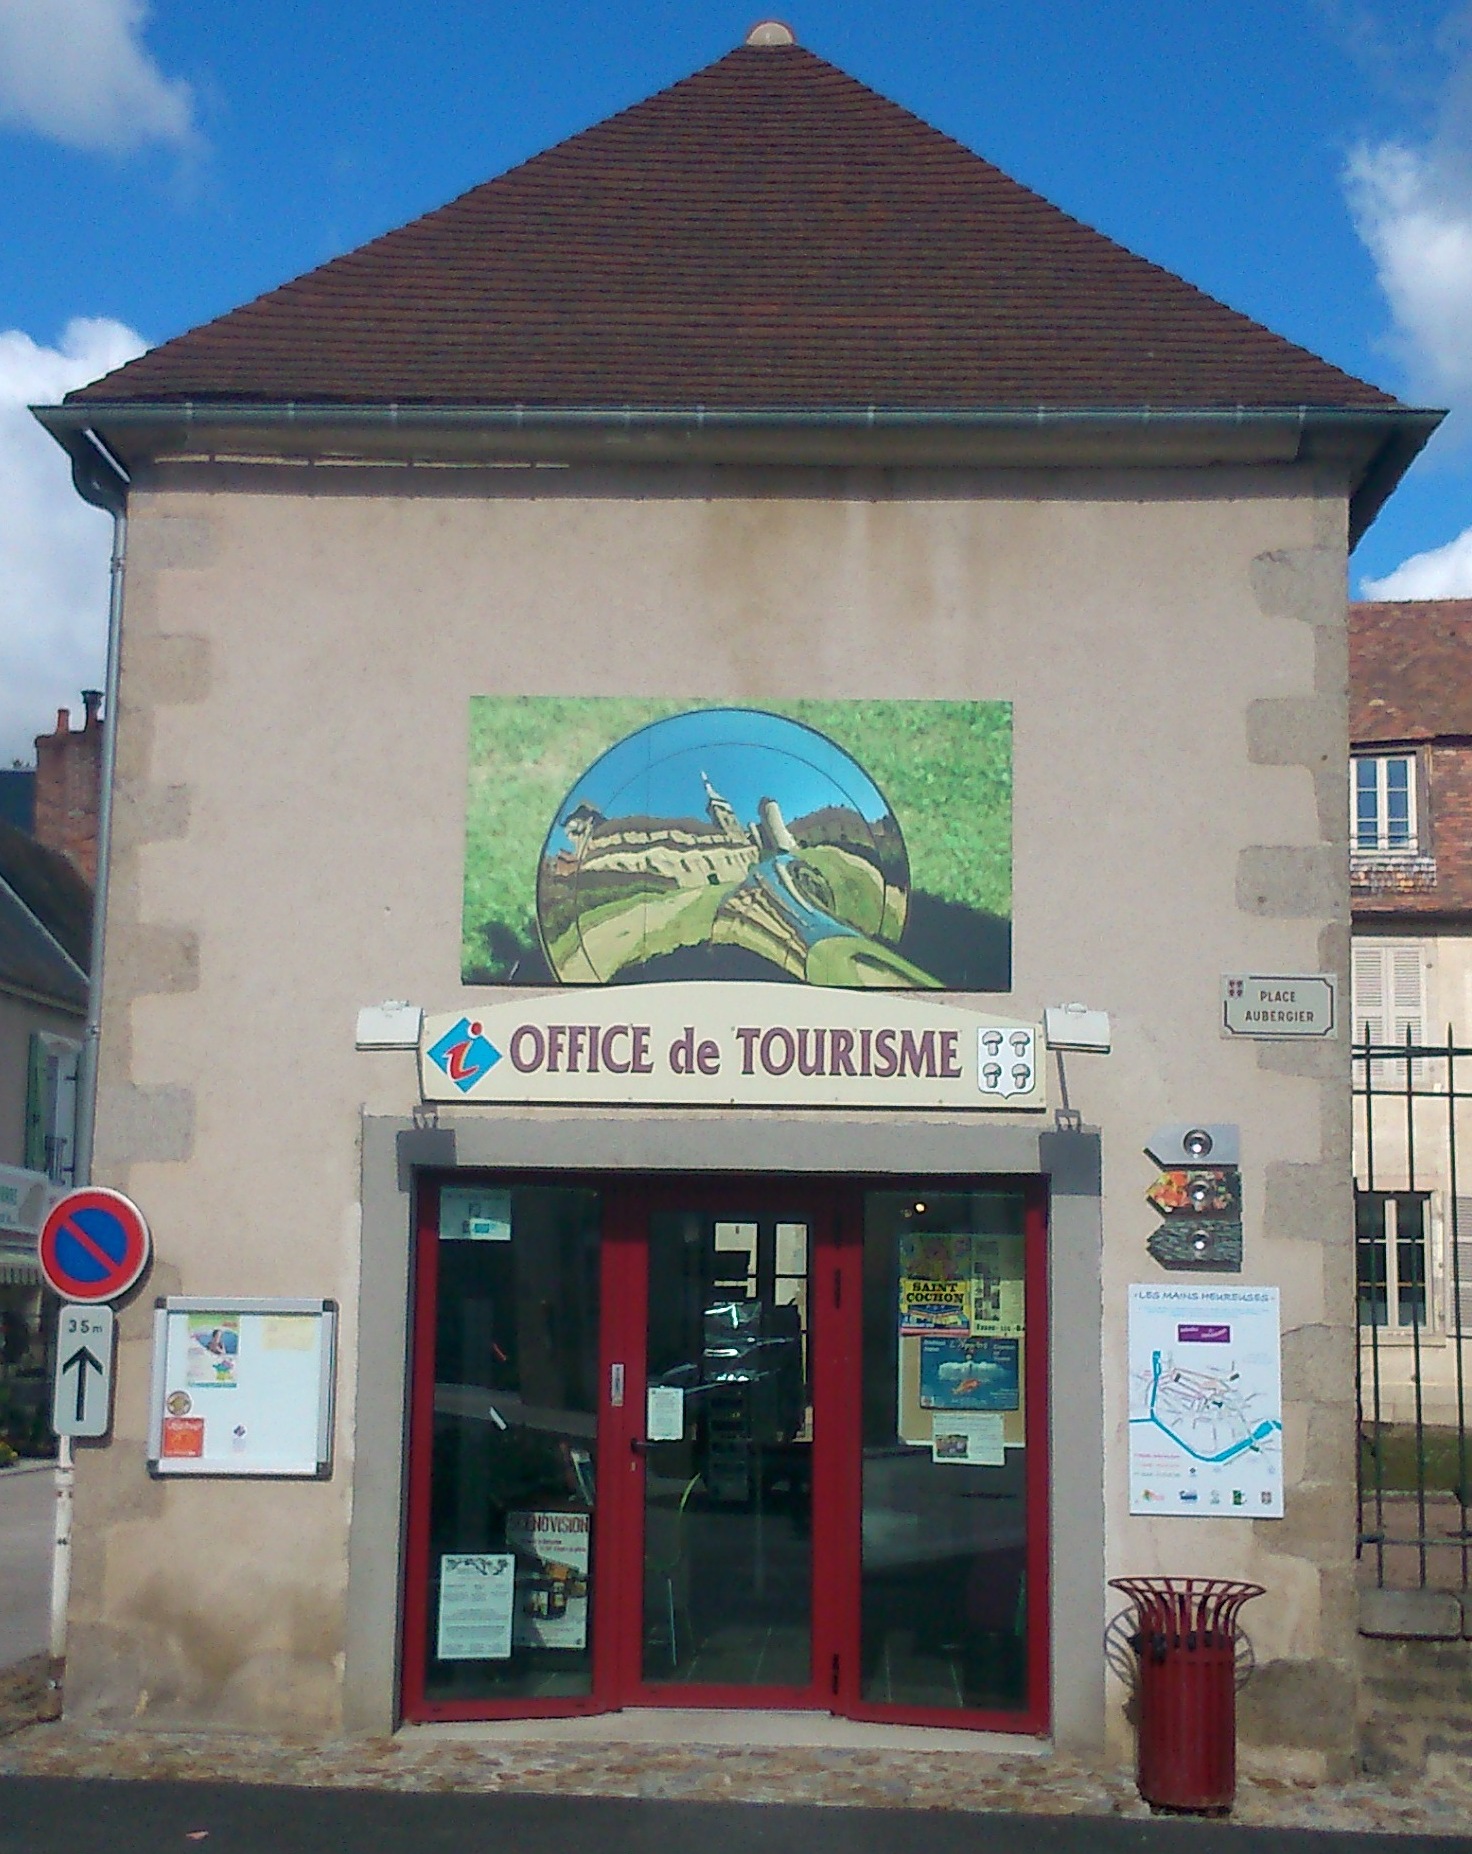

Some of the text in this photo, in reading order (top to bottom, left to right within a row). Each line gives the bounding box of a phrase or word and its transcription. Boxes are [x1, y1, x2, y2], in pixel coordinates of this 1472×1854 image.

[1260, 990, 1296, 1003] PLACE
[1245, 1010, 1314, 1022] AUBERGIER
[509, 1023, 963, 1078] OFFICE de TOURISME
[912, 1281, 958, 1292] SAINT
[906, 1292, 964, 1303] COCHON
[1162, 1291, 1199, 1300] MAINS
